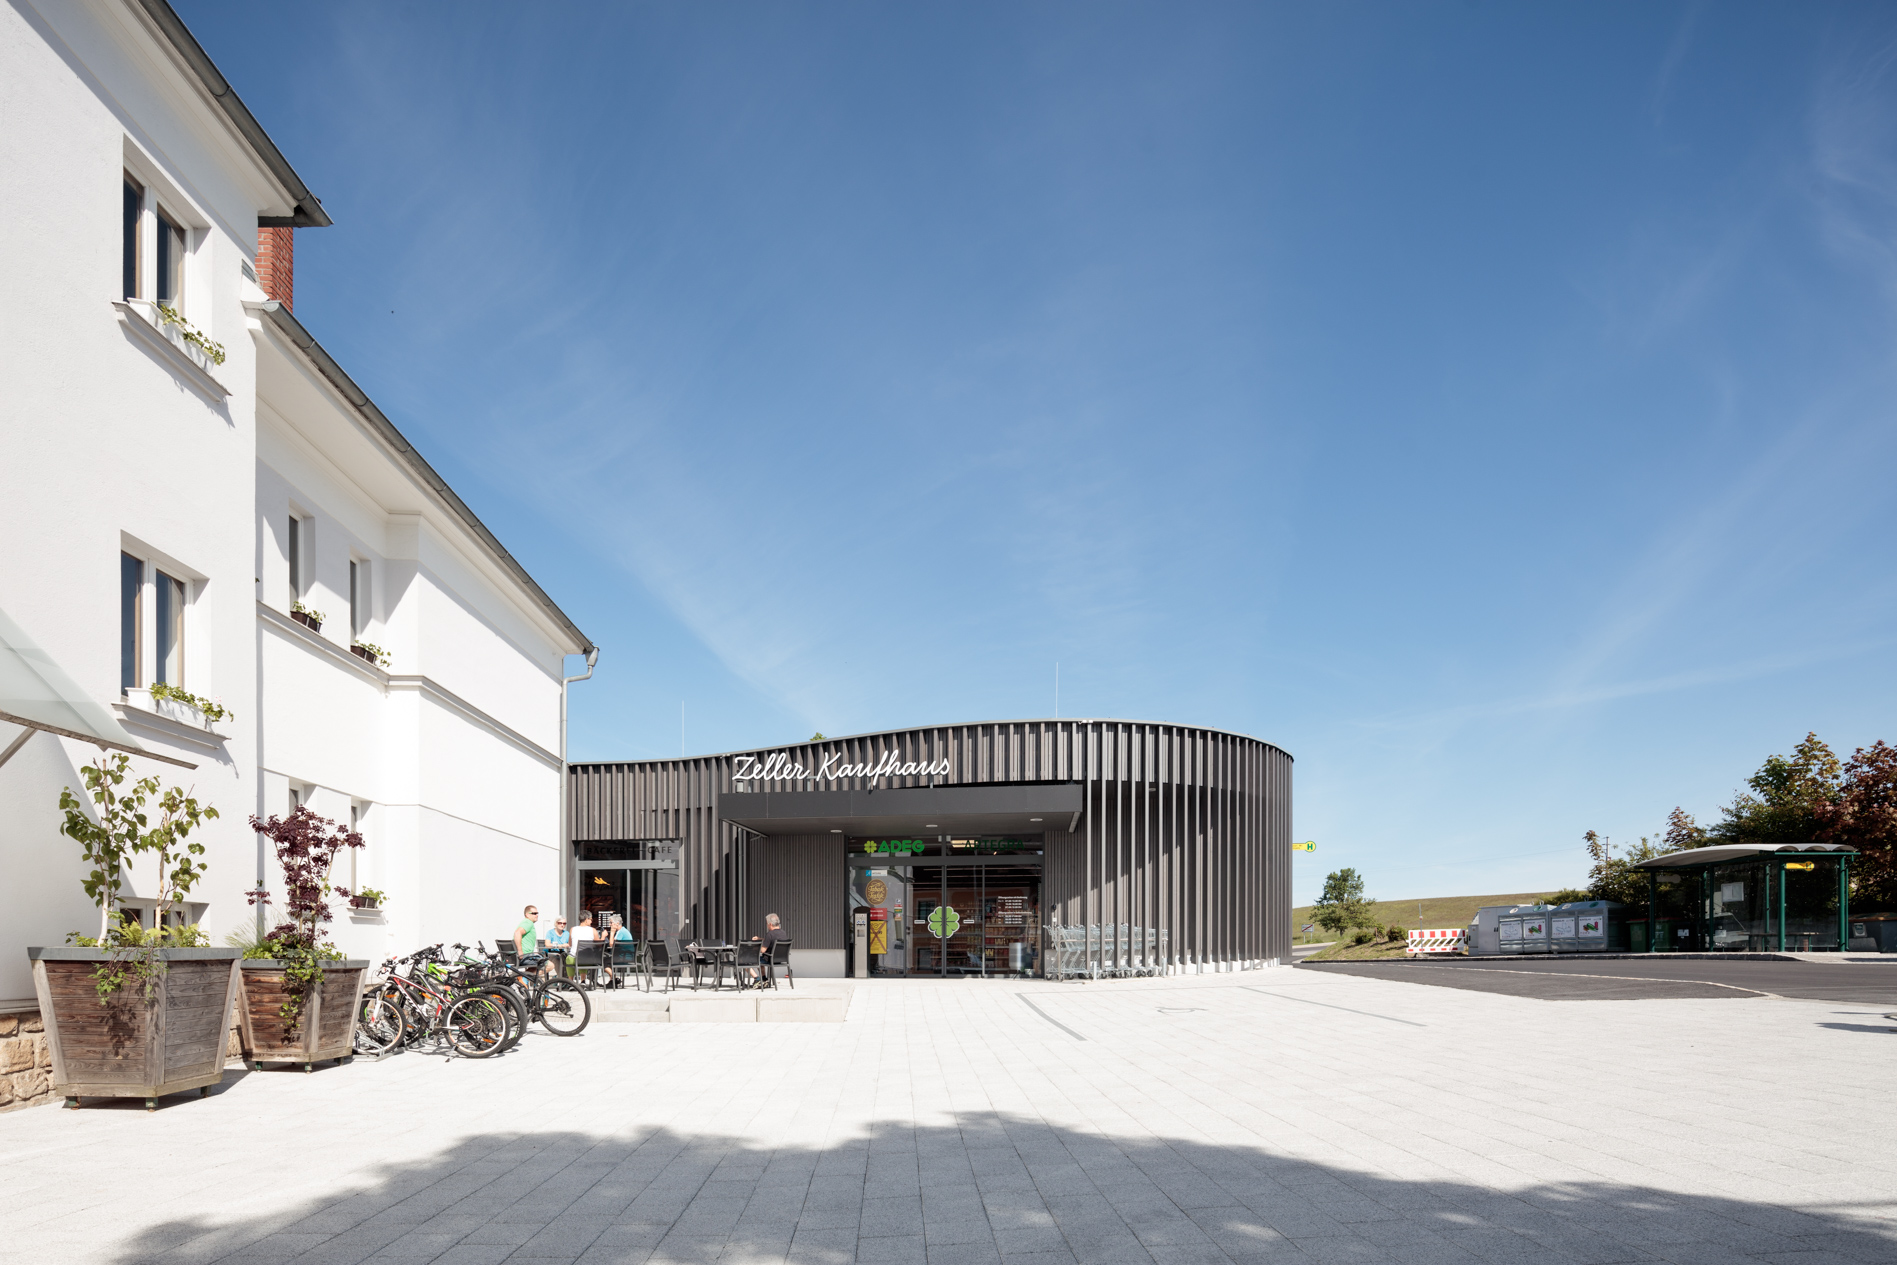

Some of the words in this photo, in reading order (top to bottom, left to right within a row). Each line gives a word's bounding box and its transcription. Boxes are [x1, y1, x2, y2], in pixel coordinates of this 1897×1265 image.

[732, 752, 810, 780] Zeller
[816, 749, 950, 786] Kaufhaus
[878, 839, 925, 853] ADEG
[964, 839, 1025, 851] ARTEGRA
